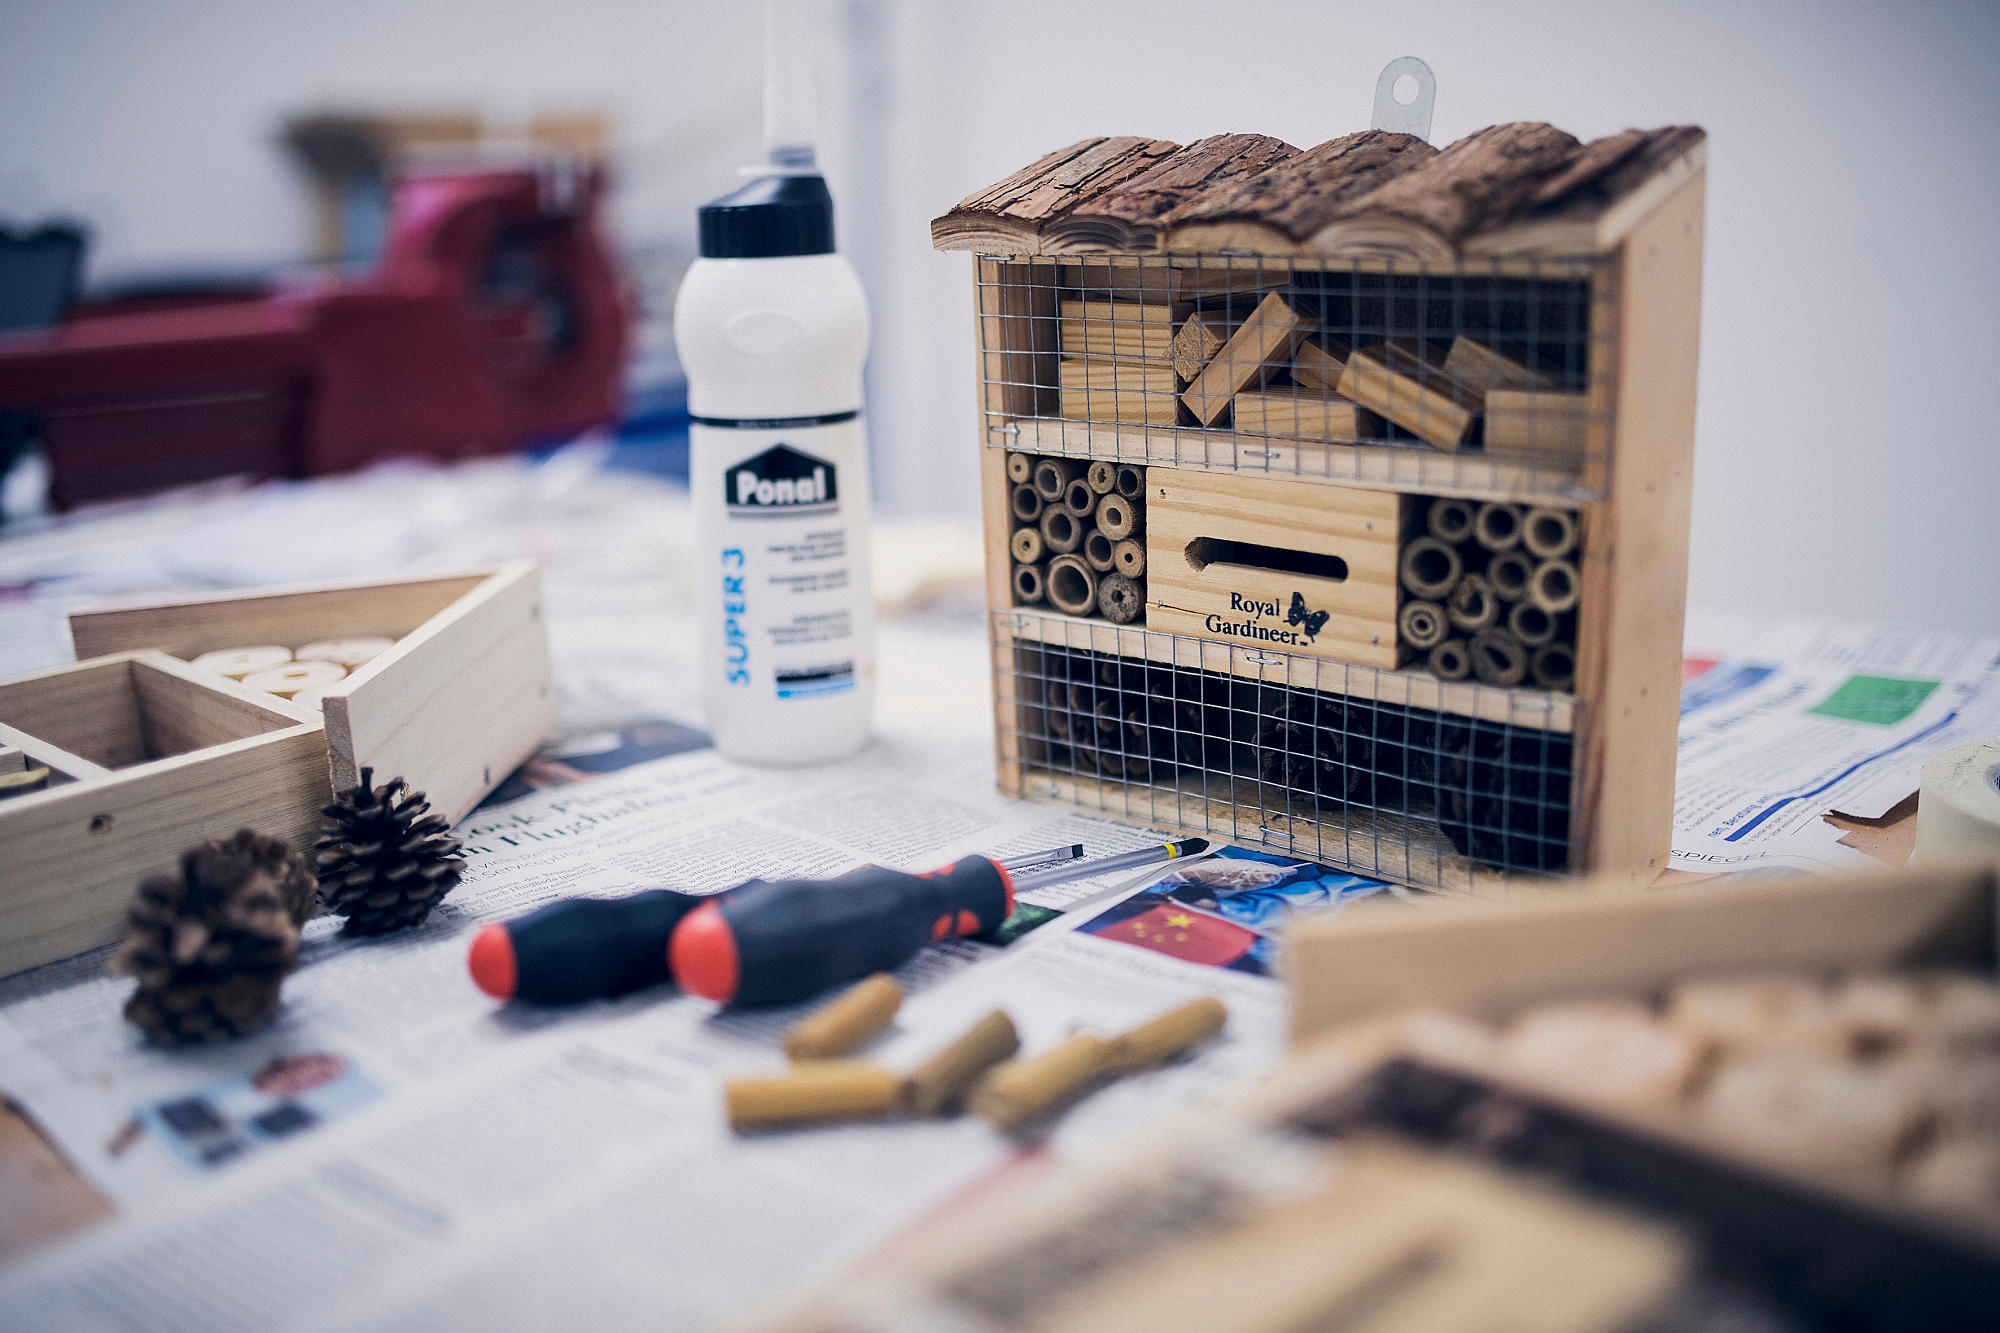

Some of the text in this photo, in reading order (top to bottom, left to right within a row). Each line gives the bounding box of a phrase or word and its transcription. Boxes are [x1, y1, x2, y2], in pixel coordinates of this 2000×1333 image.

[736, 466, 827, 505] Ponal
[721, 547, 749, 686] SUPER 3
[1230, 591, 1280, 620] Royal
[1206, 613, 1299, 645] Gardineer
